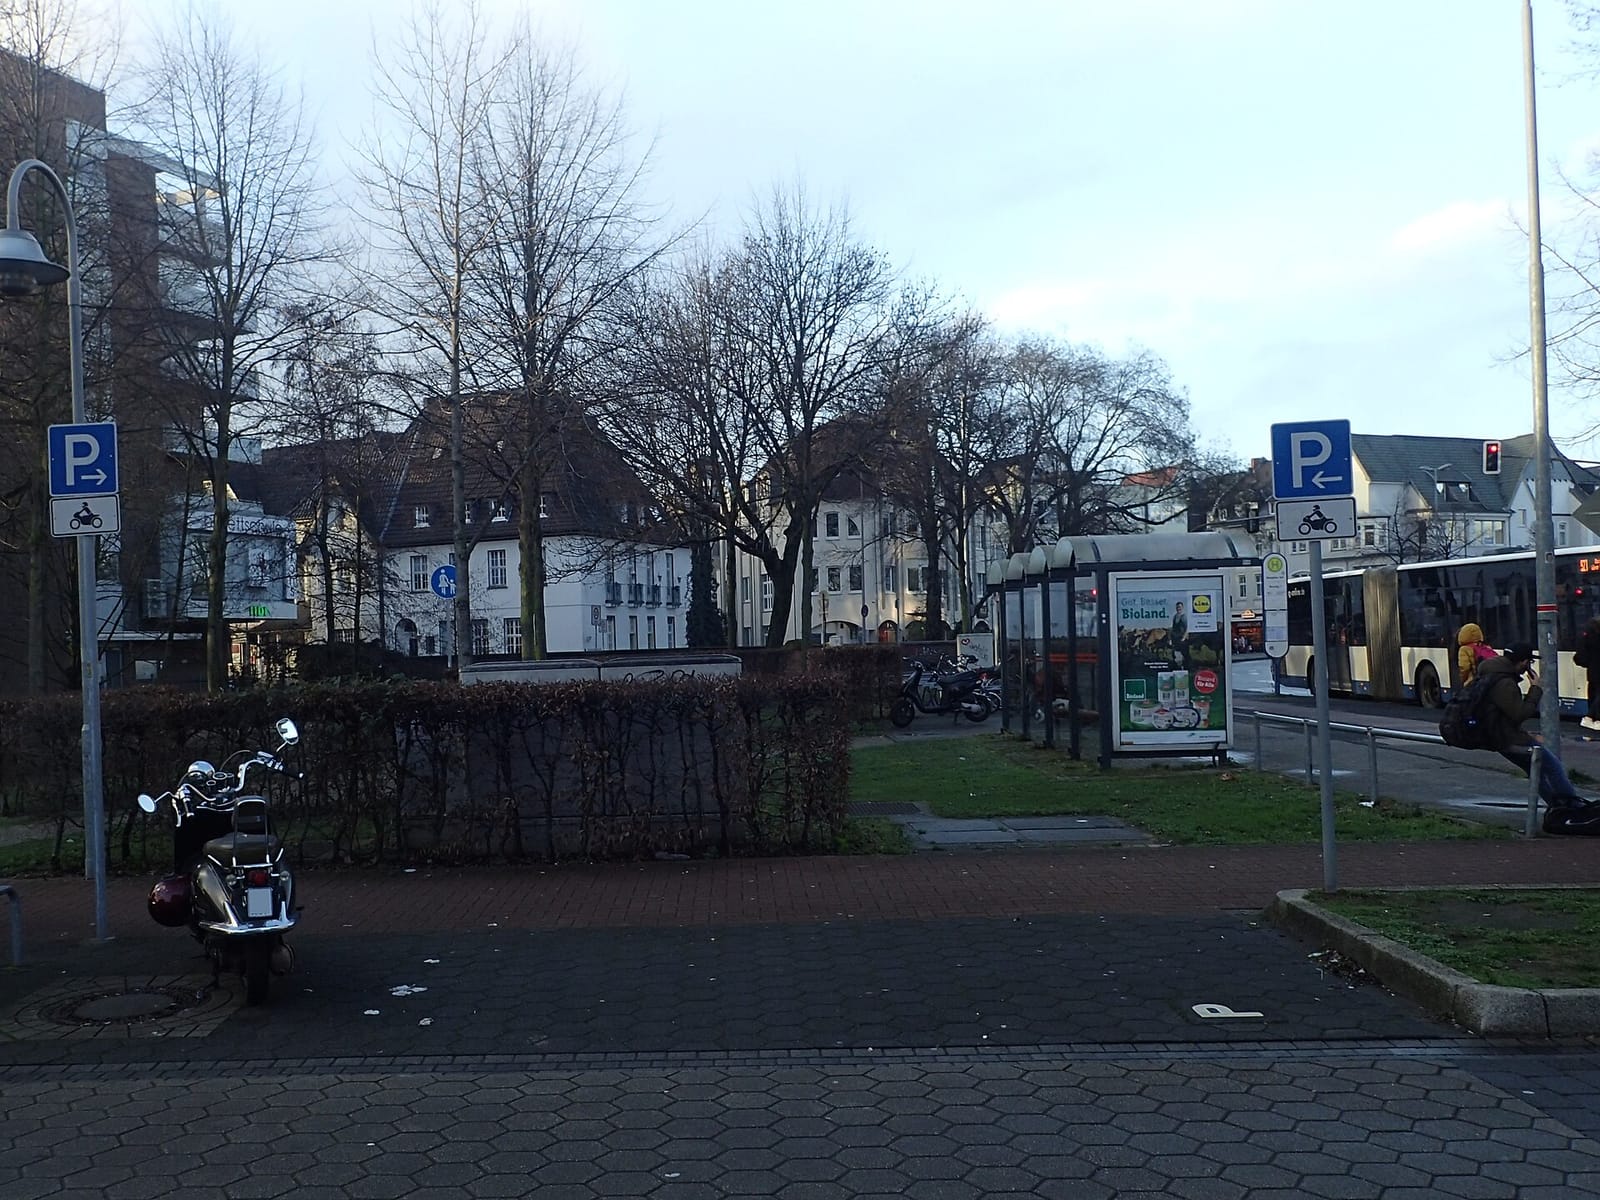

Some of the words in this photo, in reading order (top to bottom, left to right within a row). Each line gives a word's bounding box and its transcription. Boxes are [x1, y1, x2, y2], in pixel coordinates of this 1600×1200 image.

[65, 434, 100, 486] P
[1291, 432, 1332, 488] P
[1122, 608, 1169, 619] Bioland.
